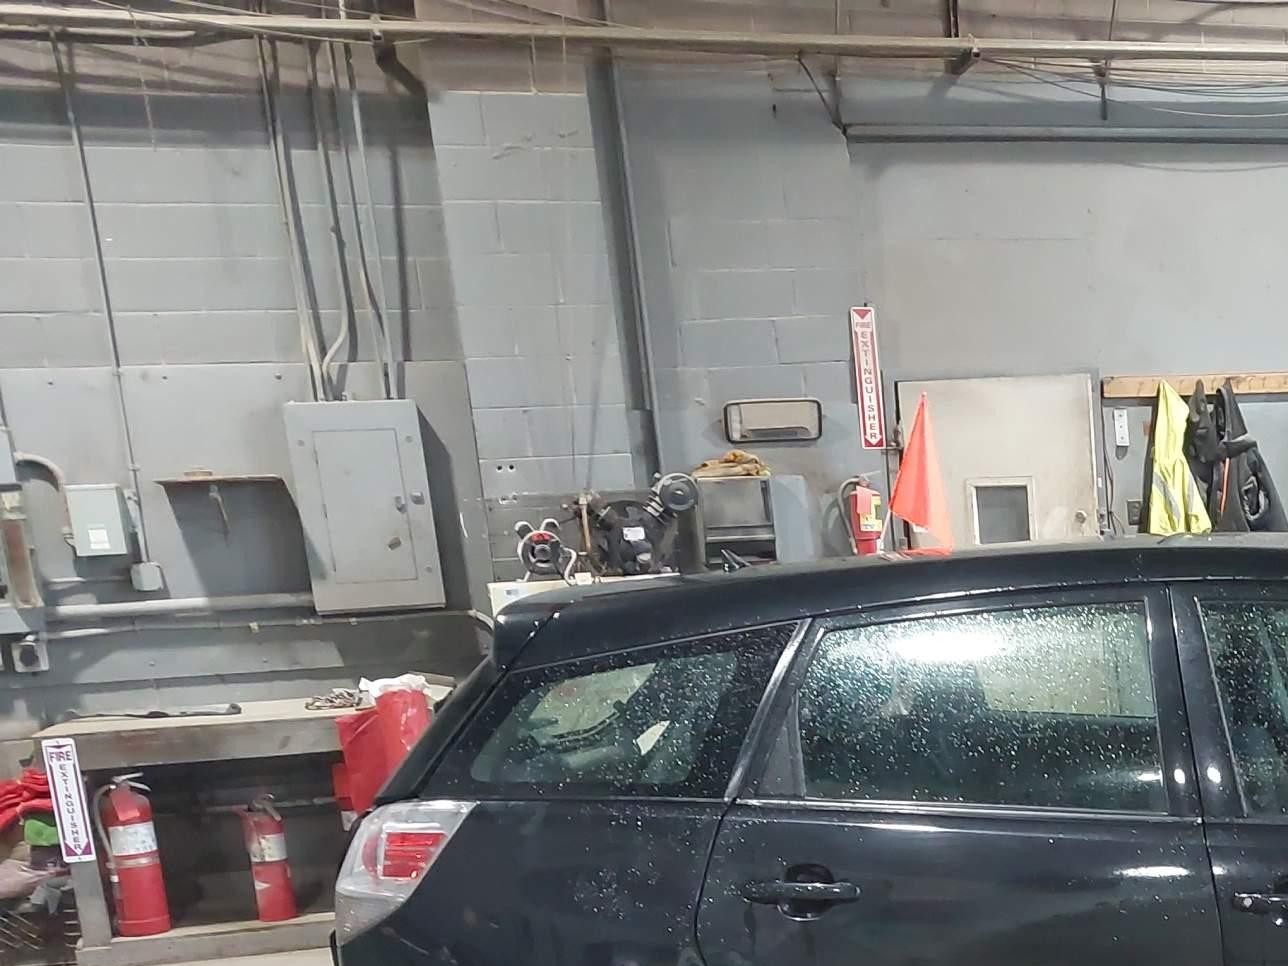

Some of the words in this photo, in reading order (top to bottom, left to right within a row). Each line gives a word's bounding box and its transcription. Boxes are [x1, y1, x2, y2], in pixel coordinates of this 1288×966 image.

[860, 330, 877, 440] EXTINGUISHER
[49, 751, 72, 761] FIRE
[59, 763, 82, 851] EXTINGUISHER
